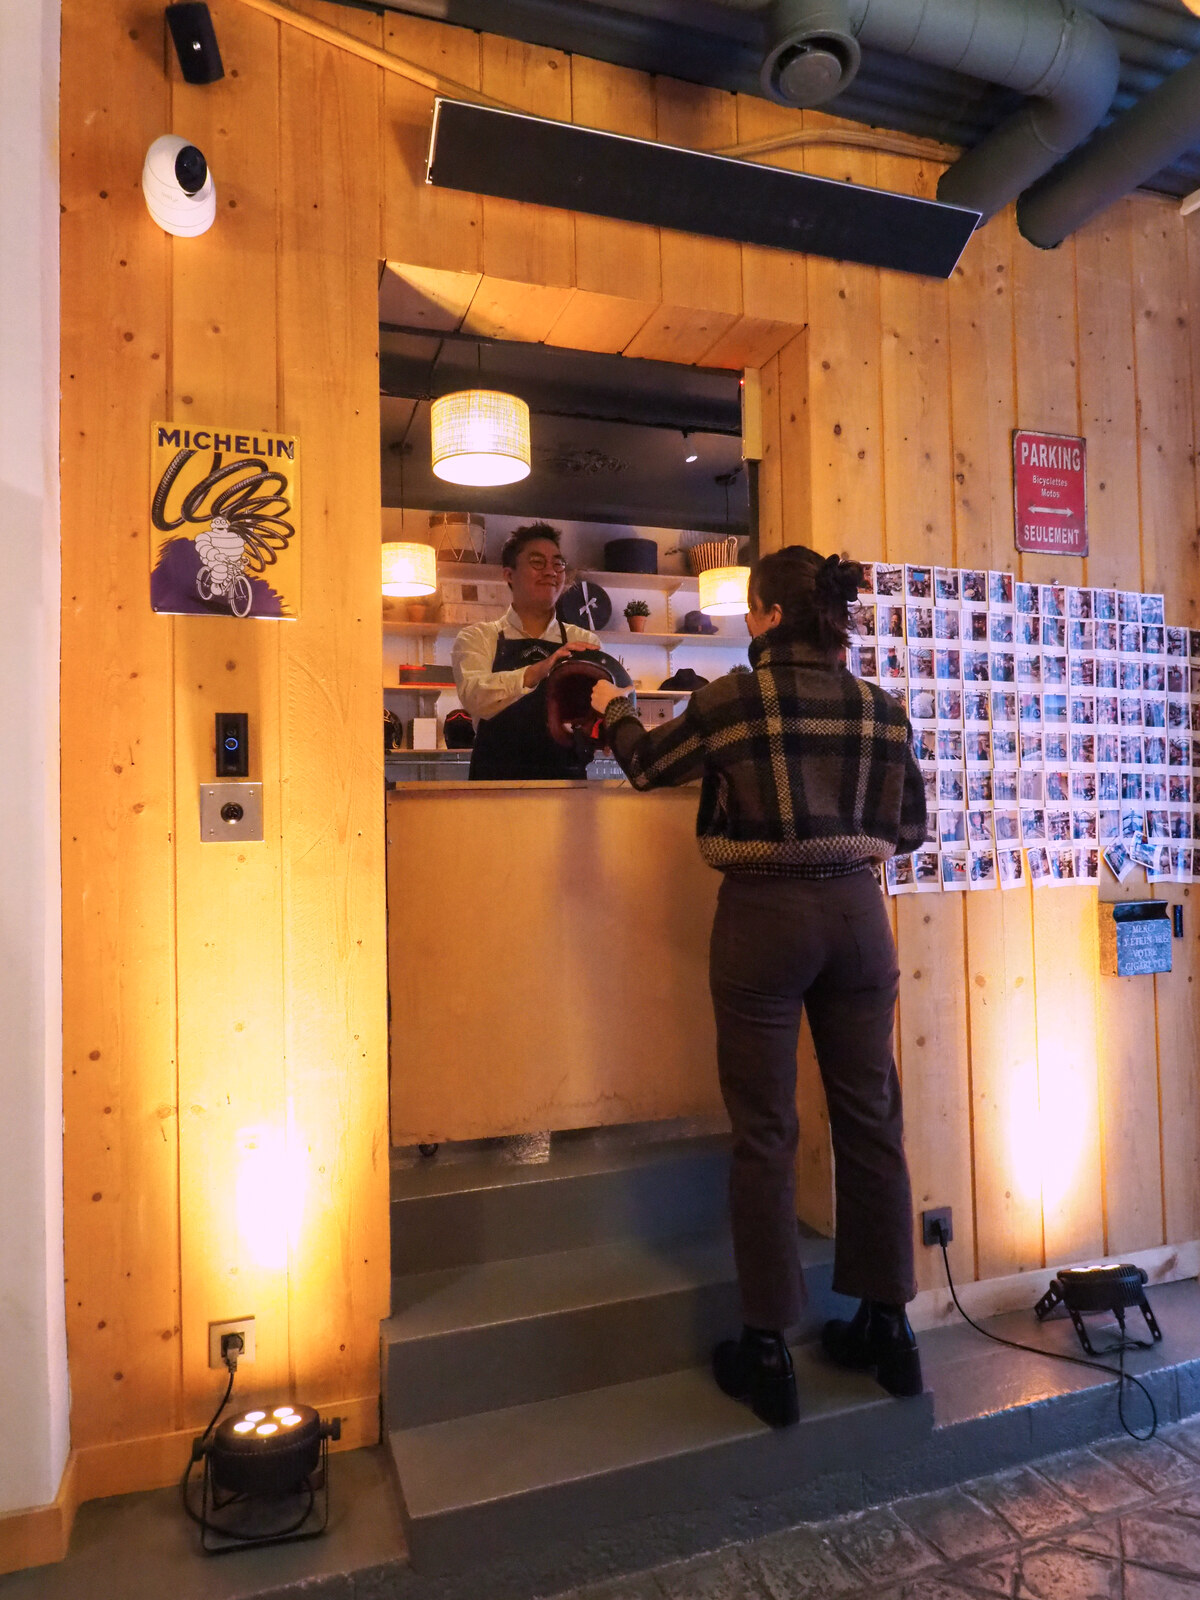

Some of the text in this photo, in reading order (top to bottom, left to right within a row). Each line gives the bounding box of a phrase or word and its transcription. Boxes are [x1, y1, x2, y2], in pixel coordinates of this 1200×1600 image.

[158, 427, 295, 459] MICHELIN
[1021, 442, 1081, 472] PARKING
[1032, 475, 1068, 487] Bicyclettes
[1041, 488, 1060, 498] Motos
[1024, 524, 1080, 545] SEULEMENT
